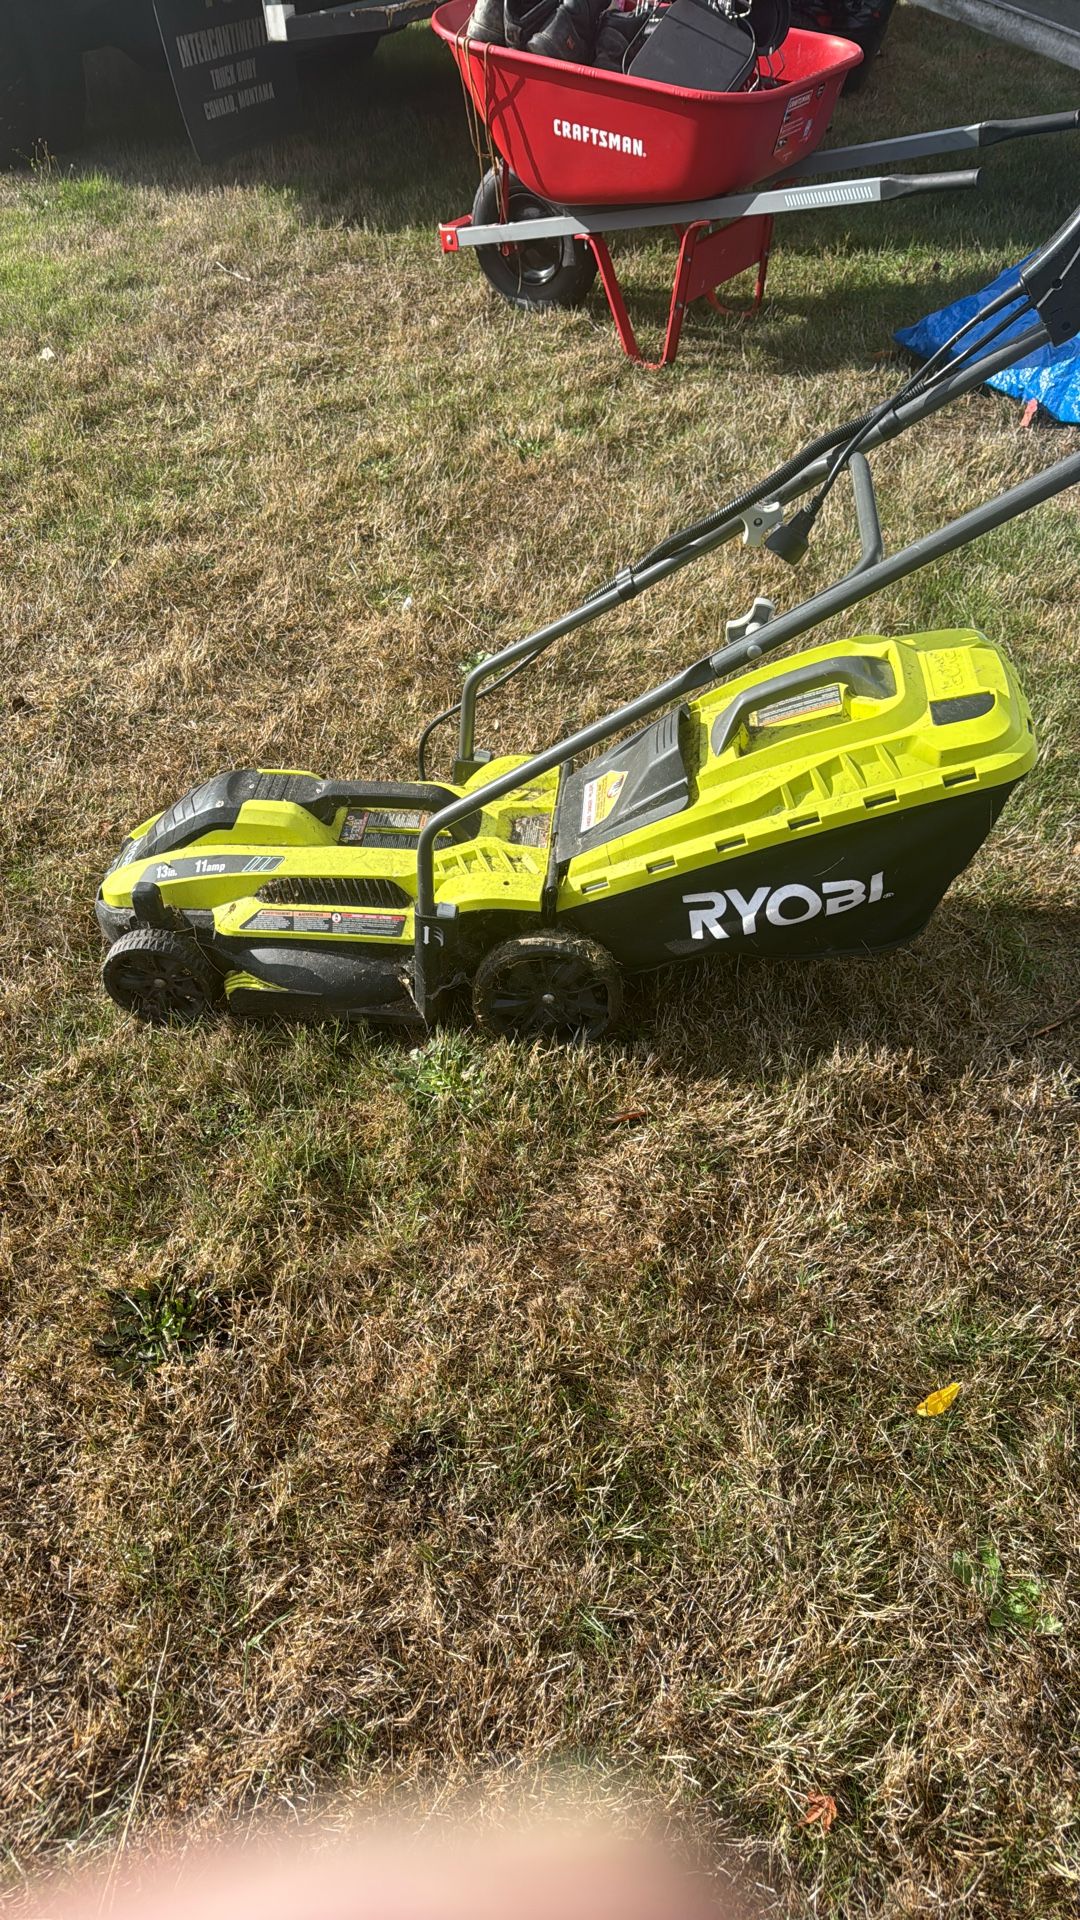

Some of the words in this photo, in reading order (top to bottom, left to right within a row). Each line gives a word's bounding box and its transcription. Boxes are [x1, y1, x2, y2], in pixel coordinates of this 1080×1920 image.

[210, 64, 236, 90] TRUCK
[236, 57, 257, 82] BODY
[203, 94, 239, 120] CONRAD,
[237, 81, 275, 109] MONTANA
[553, 118, 644, 157] CRAFTSMAN
[682, 871, 884, 940] RYOBI
